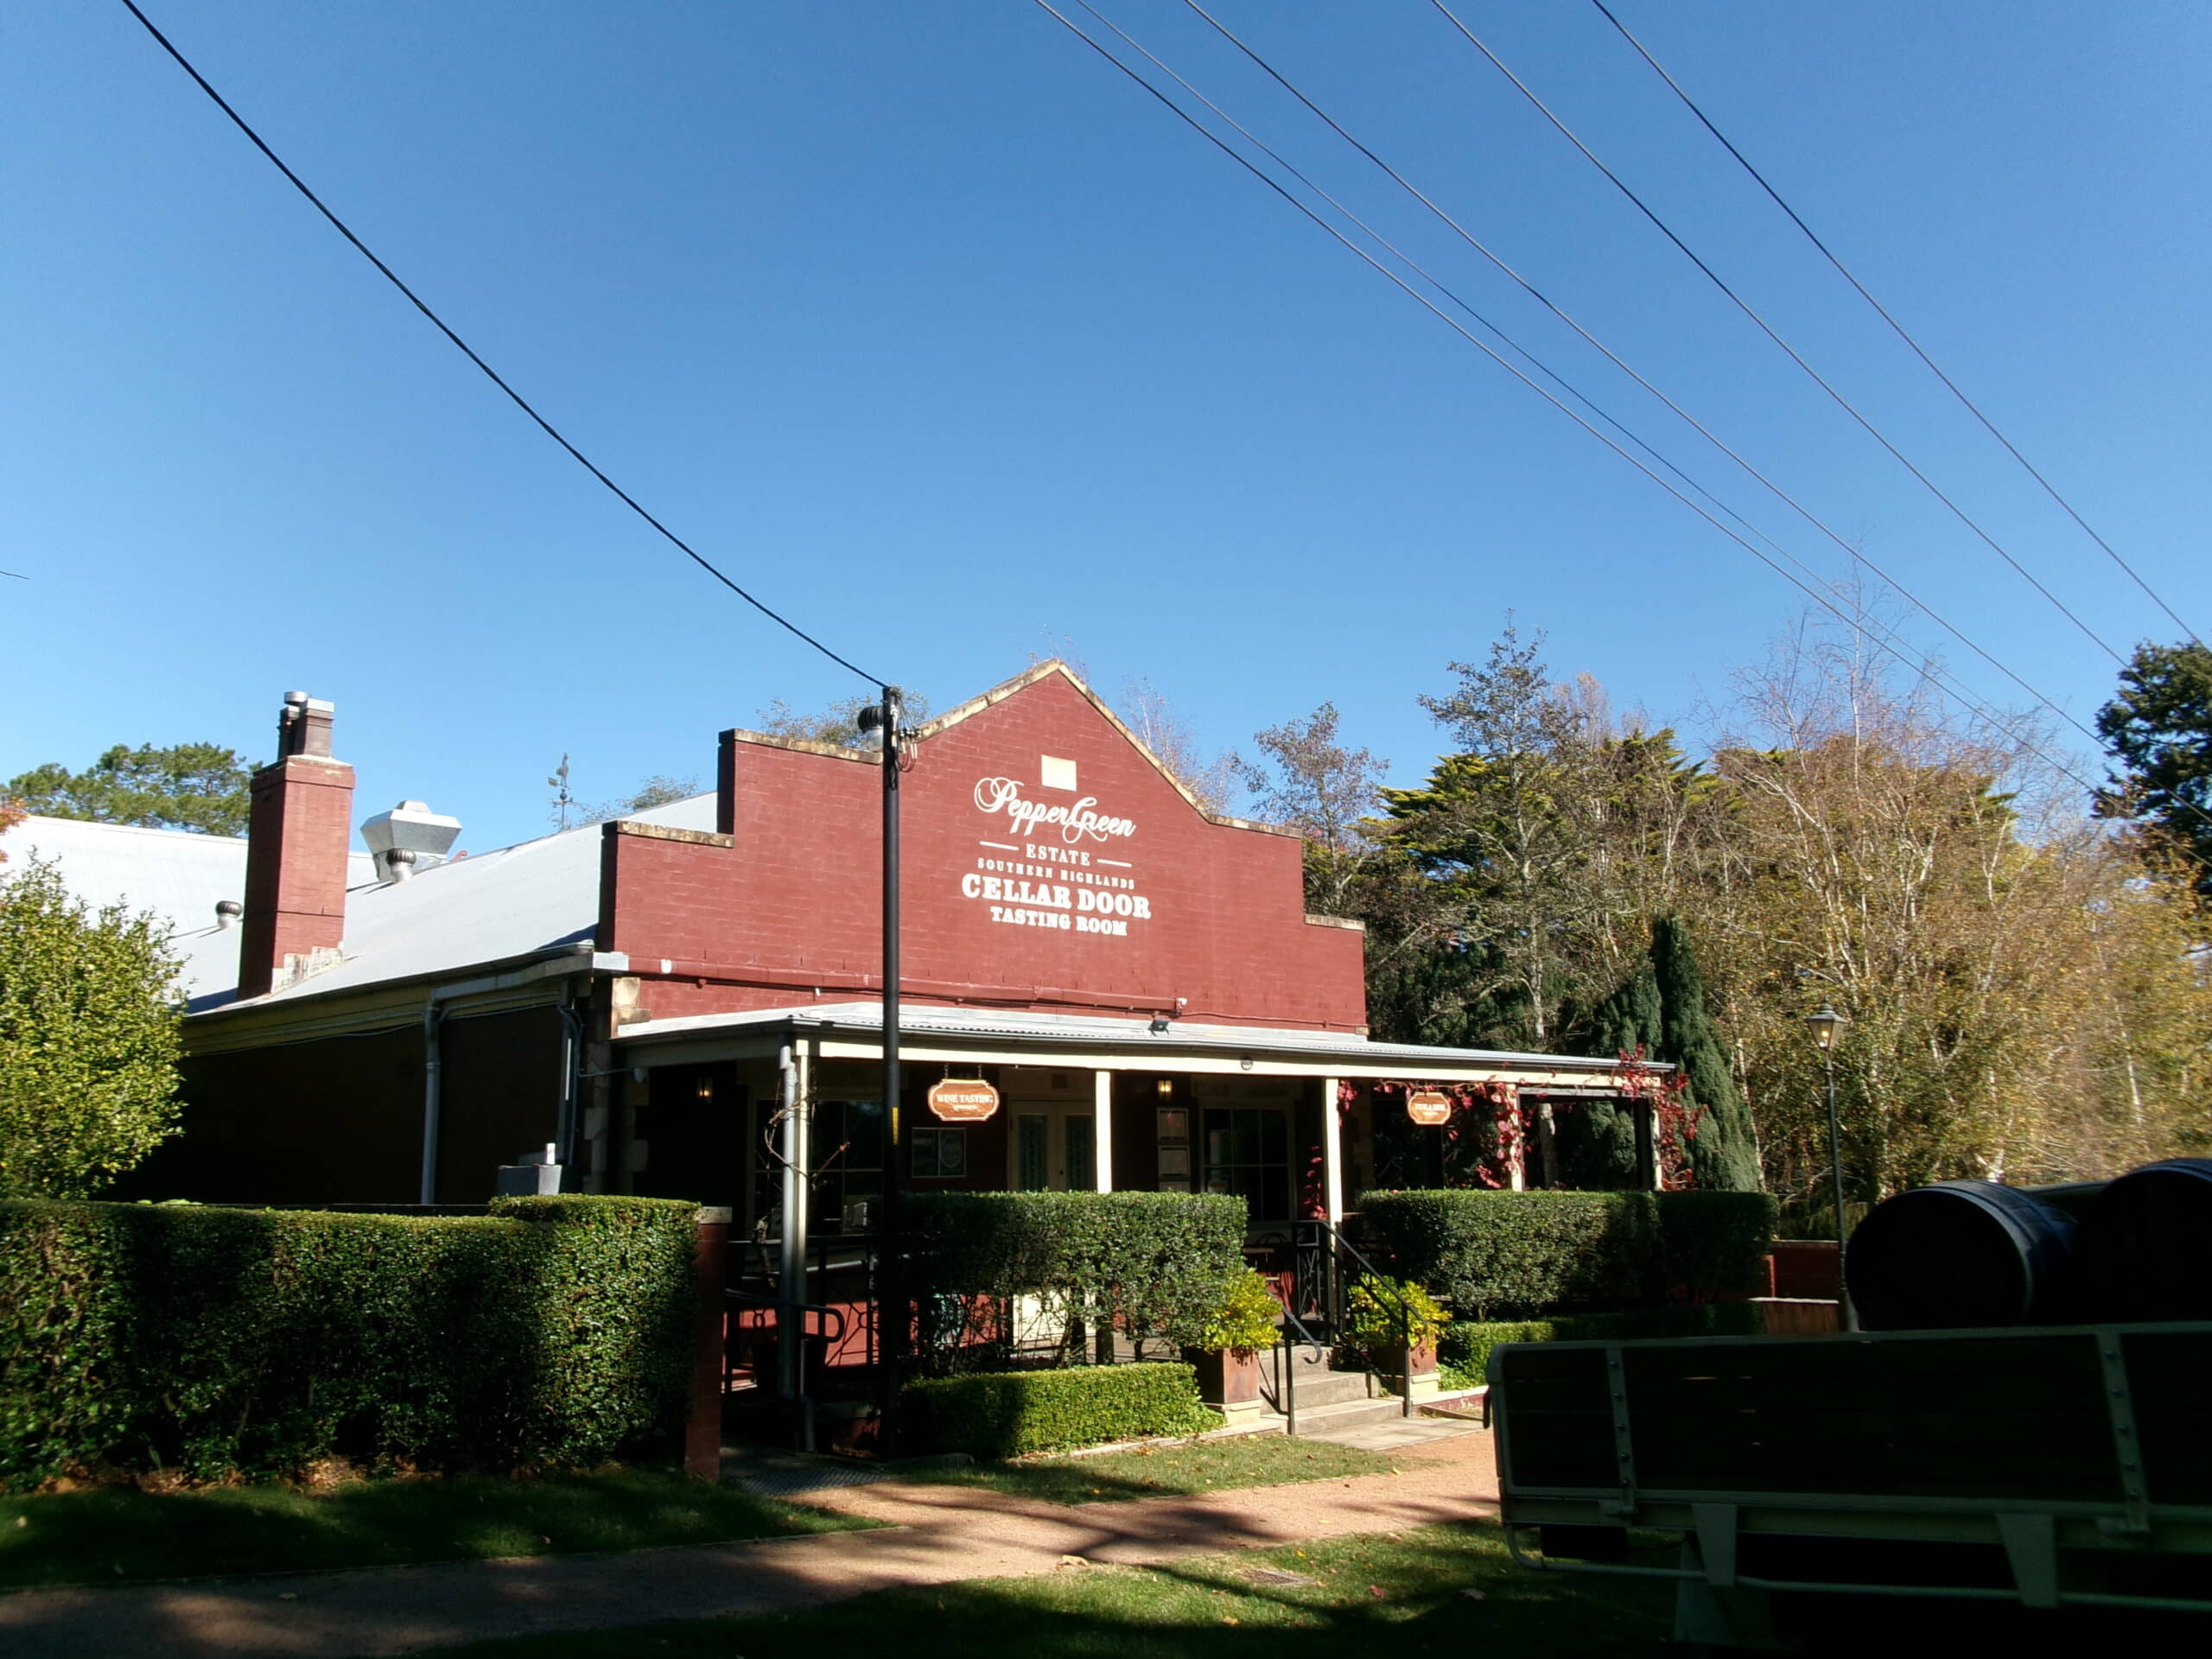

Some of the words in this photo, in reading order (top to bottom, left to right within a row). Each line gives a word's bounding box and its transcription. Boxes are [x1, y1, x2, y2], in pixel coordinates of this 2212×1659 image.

[1026, 843, 1090, 866] ESTATE
[977, 857, 1053, 878] SOUTHERN
[1060, 869, 1135, 890] HIGHLANDS
[962, 873, 1072, 909] CELLAR
[1077, 888, 1152, 919] DOOR
[989, 906, 1071, 930] TASTING
[1075, 916, 1128, 937] ROOM
